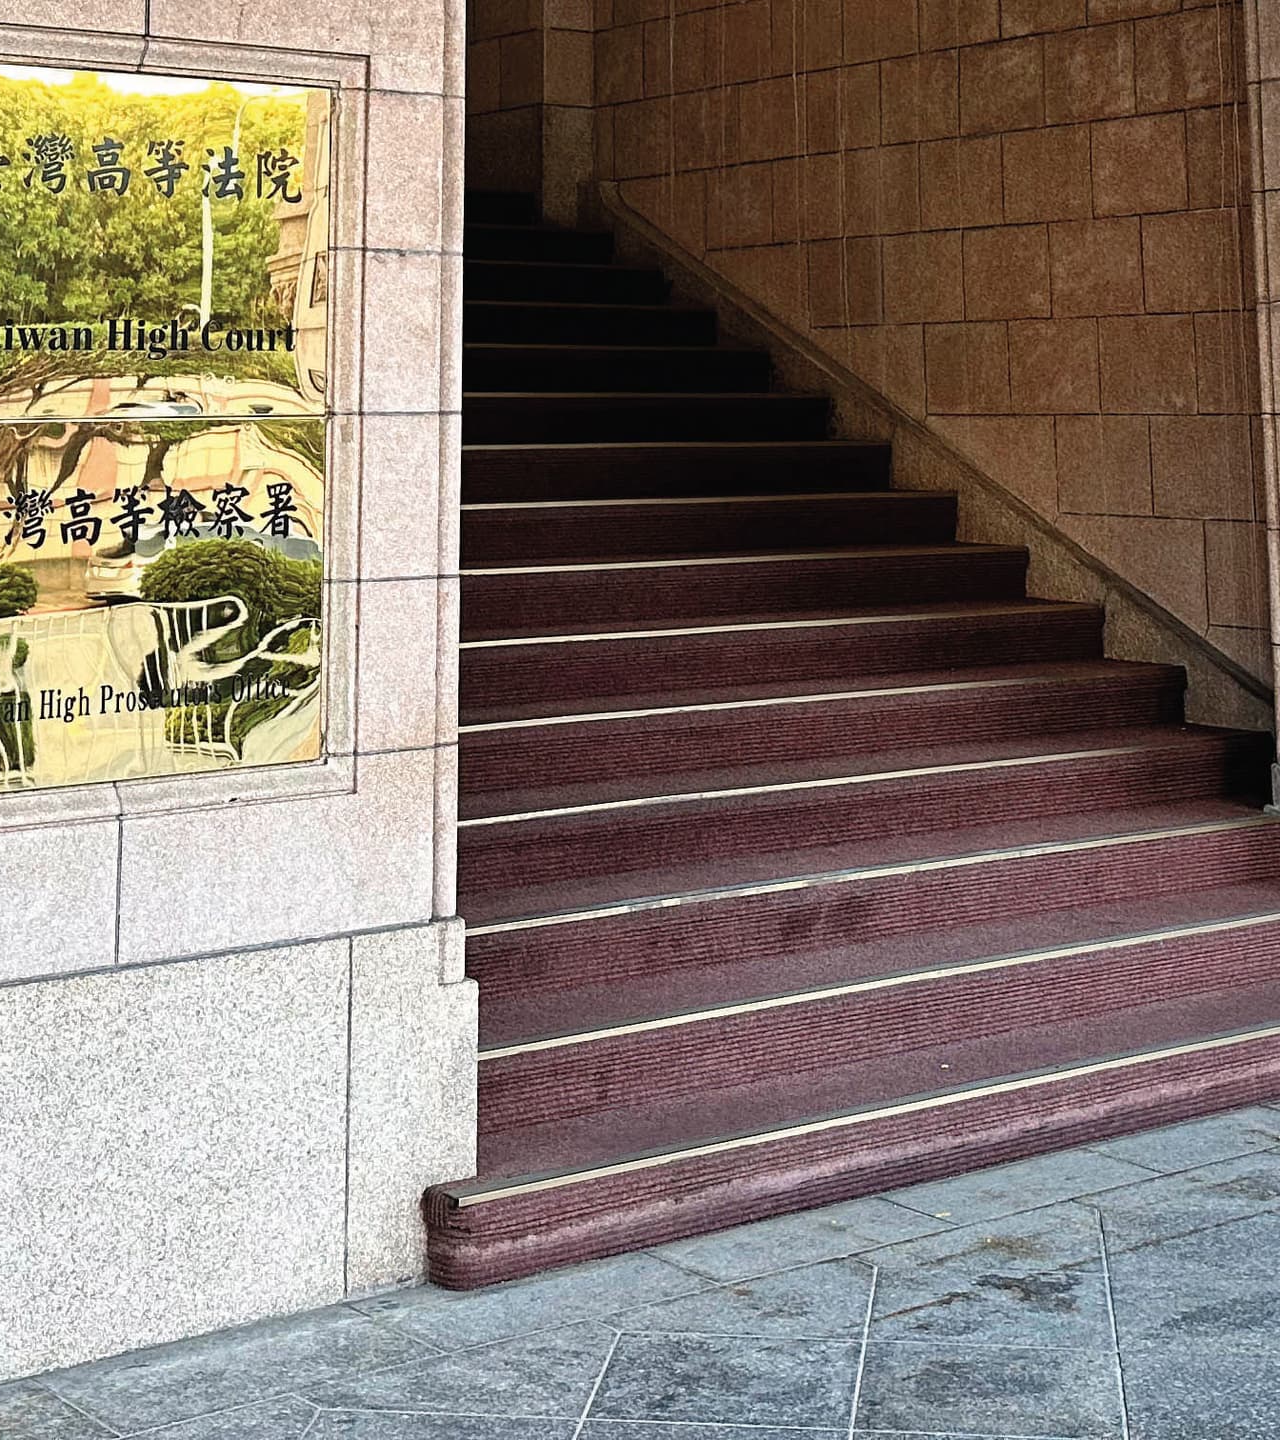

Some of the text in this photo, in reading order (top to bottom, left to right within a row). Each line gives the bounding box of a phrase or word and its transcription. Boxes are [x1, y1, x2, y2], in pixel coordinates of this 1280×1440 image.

[107, 318, 189, 360] High
[201, 318, 299, 352] Court
[39, 687, 90, 723] High
[99, 677, 221, 714] Prosecutors
[232, 672, 290, 704] Office
